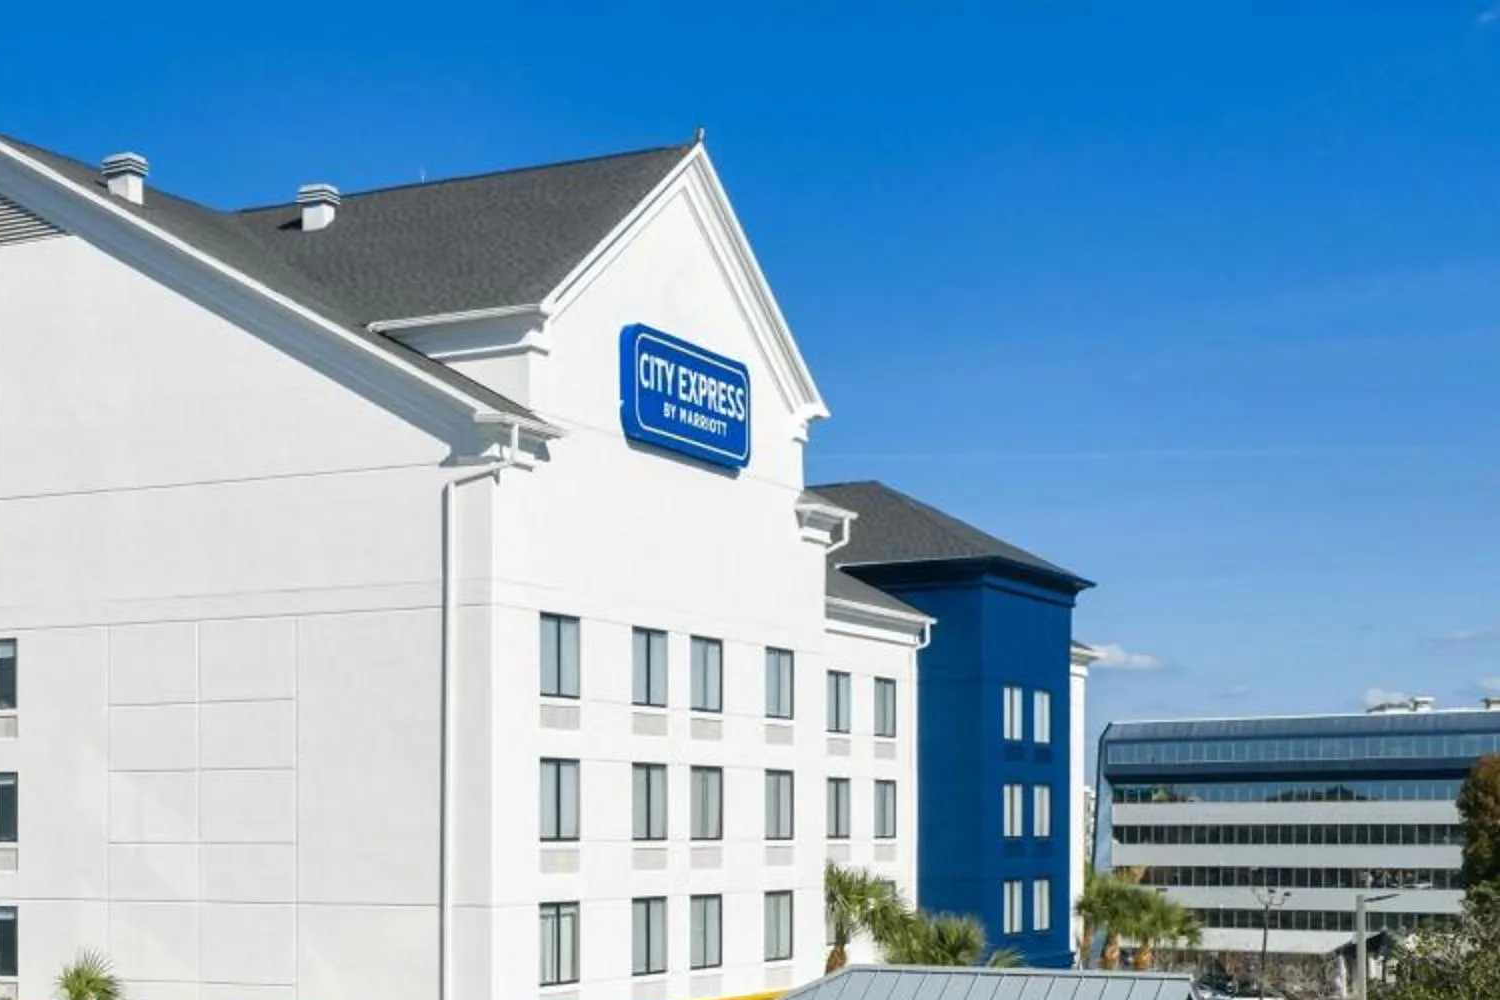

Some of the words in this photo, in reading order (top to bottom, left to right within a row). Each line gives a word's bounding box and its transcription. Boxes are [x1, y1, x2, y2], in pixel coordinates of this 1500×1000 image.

[639, 353, 675, 396] CITY
[678, 366, 745, 421] EXPRESS
[663, 402, 676, 420] BY
[679, 408, 728, 437] MARRIOTT
